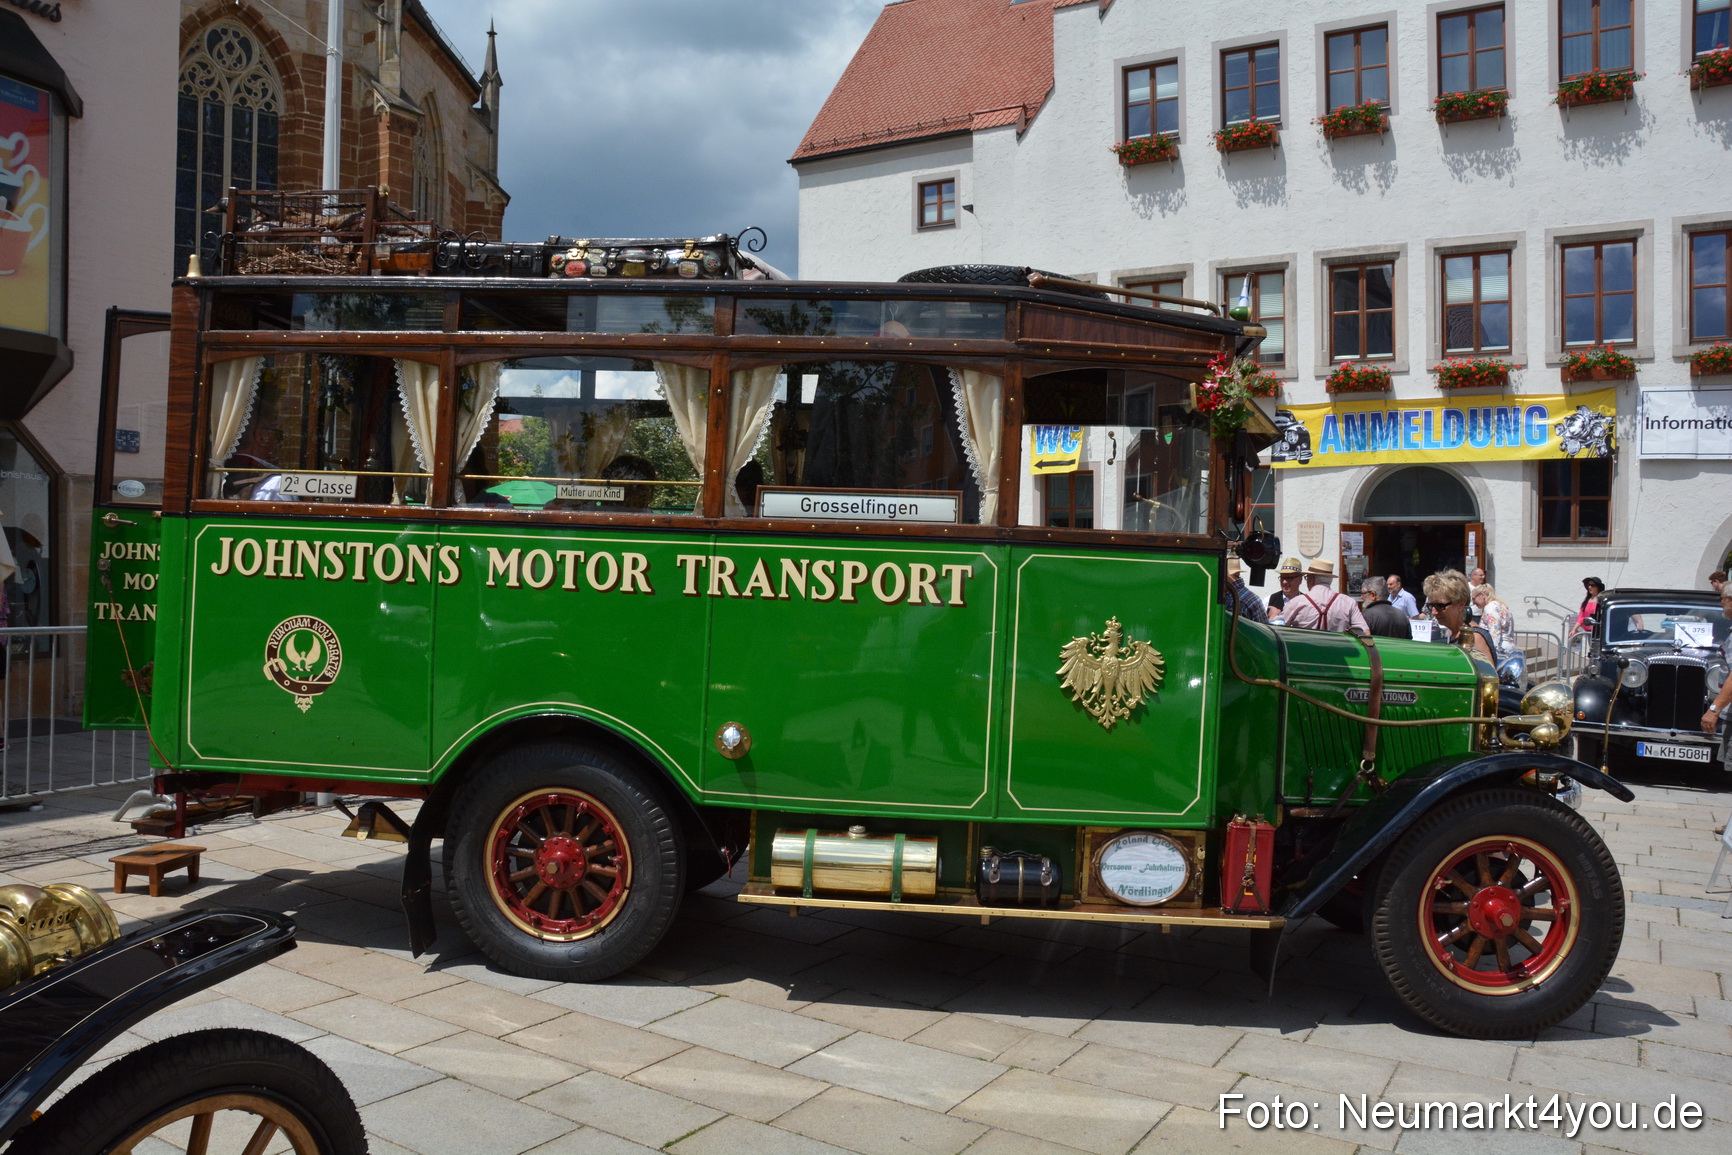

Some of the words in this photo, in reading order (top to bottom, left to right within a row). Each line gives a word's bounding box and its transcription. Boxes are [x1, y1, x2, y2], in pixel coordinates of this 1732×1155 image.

[1318, 404, 1550, 454] ANMELDUNG
[1034, 425, 1080, 455] WC
[305, 478, 353, 495] Classe
[560, 487, 586, 497] Mutter
[587, 489, 602, 498] und
[603, 488, 621, 499] Kind
[800, 497, 919, 519] Grosselfingen
[211, 537, 461, 585] JOHNSTON'S
[486, 547, 653, 594] MOTOR
[677, 553, 974, 606] TRANSPORT
[123, 572, 159, 591] MO
[269, 617, 312, 649] NUNQUAM
[312, 620, 332, 639] NON
[324, 637, 340, 679] PARATUS
[1349, 690, 1413, 702] INTEATIONAL
[1644, 745, 1653, 756] N
[1660, 745, 1676, 758] KH
[1678, 747, 1710, 761] 508H
[1111, 836, 1148, 852] Roland
[1117, 883, 1173, 898] Nördlingen
